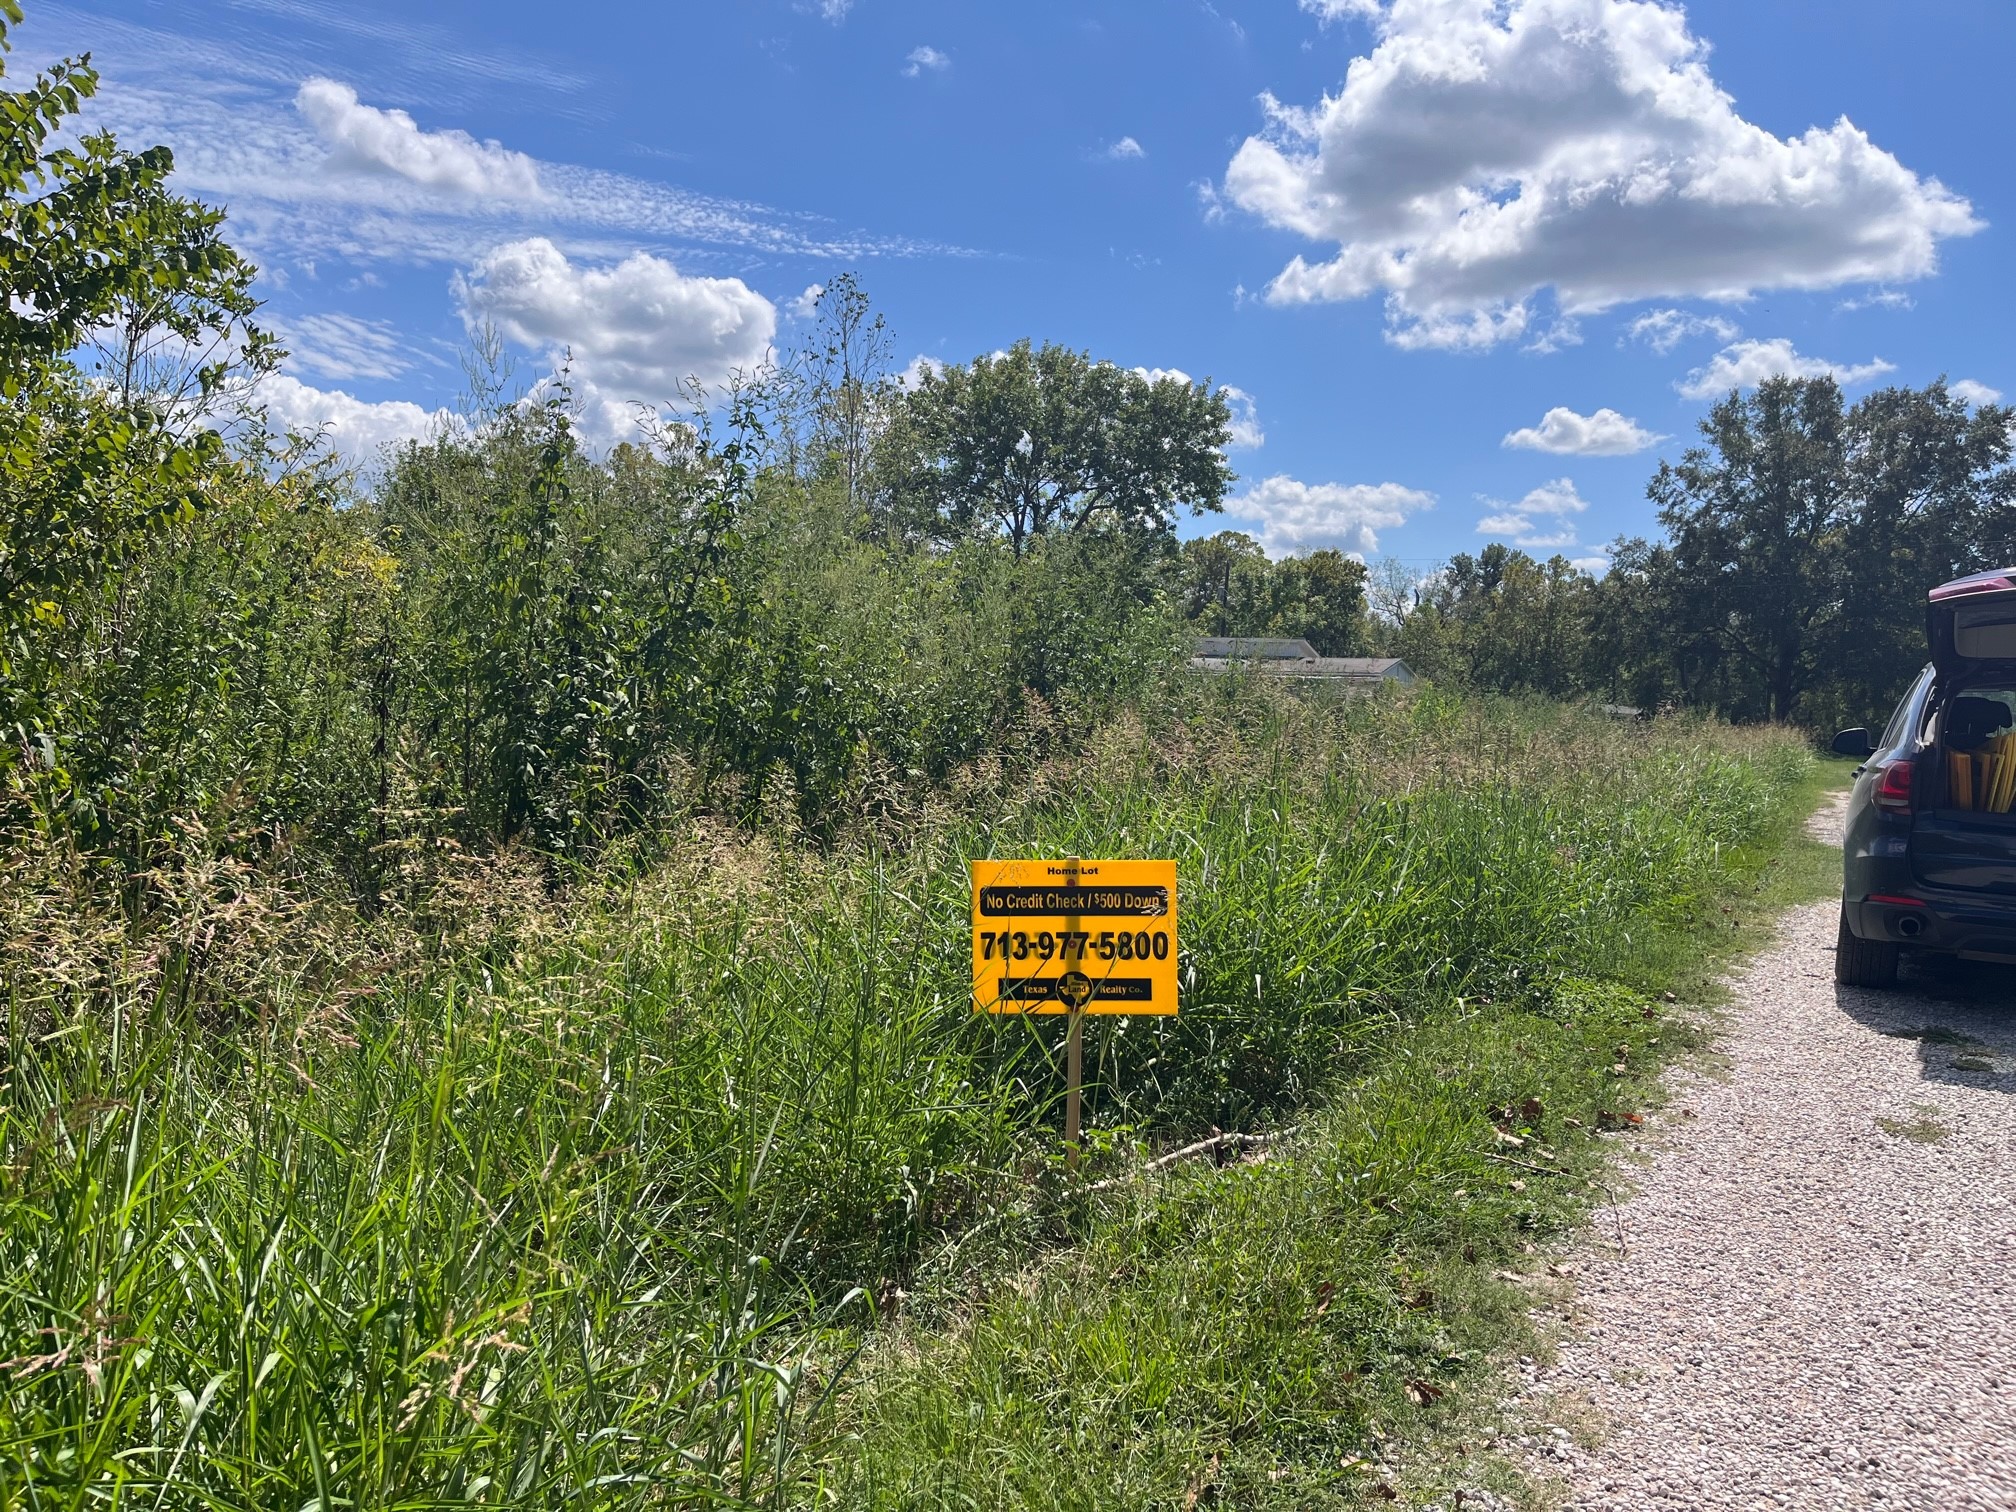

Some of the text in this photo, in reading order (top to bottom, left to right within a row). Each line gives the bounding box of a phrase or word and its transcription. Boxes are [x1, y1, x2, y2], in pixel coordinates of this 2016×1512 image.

[1047, 867, 1099, 875] Home Lot
[986, 892, 1160, 909] No Credit Check / $500 Down
[980, 931, 1169, 961] 713-977-5800
[1024, 985, 1048, 993] Texas
[1068, 985, 1086, 993] Land
[1100, 985, 1127, 995] Realty
